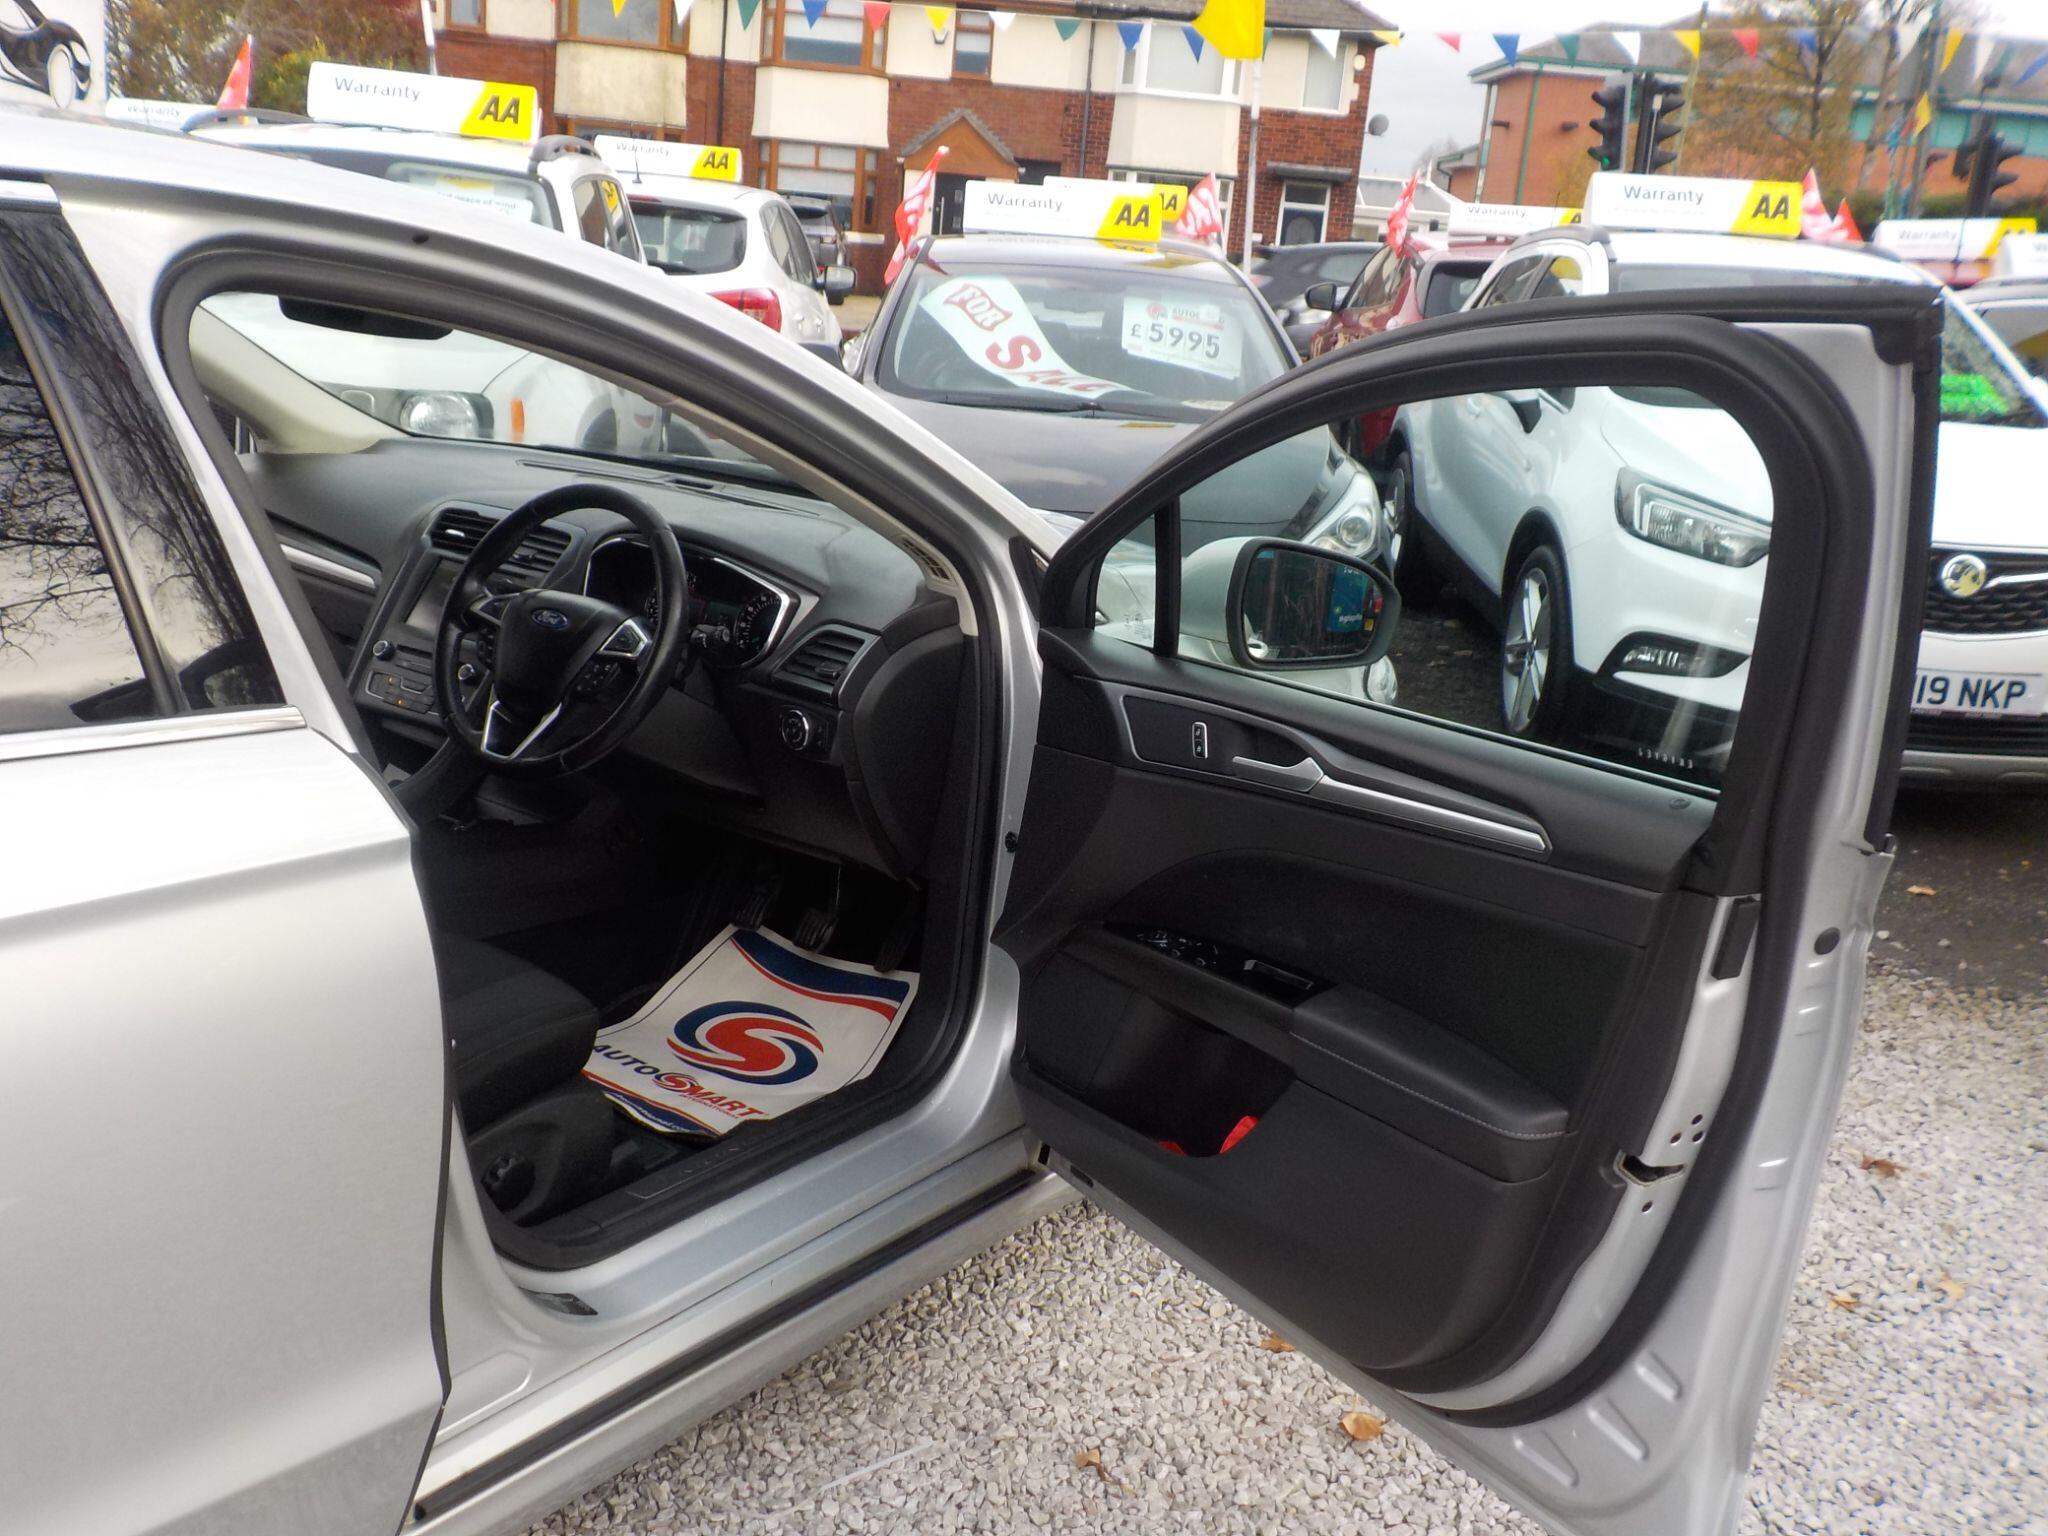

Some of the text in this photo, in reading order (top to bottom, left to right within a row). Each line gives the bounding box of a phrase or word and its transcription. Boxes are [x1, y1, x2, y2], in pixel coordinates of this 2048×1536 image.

[334, 77, 521, 125] Warranty AA
[703, 151, 729, 170] AA
[987, 192, 1150, 228] Warranty AA
[1623, 185, 1790, 220] Warranty AA
[951, 285, 1006, 330] FOR
[1957, 677, 2027, 709] NKP
